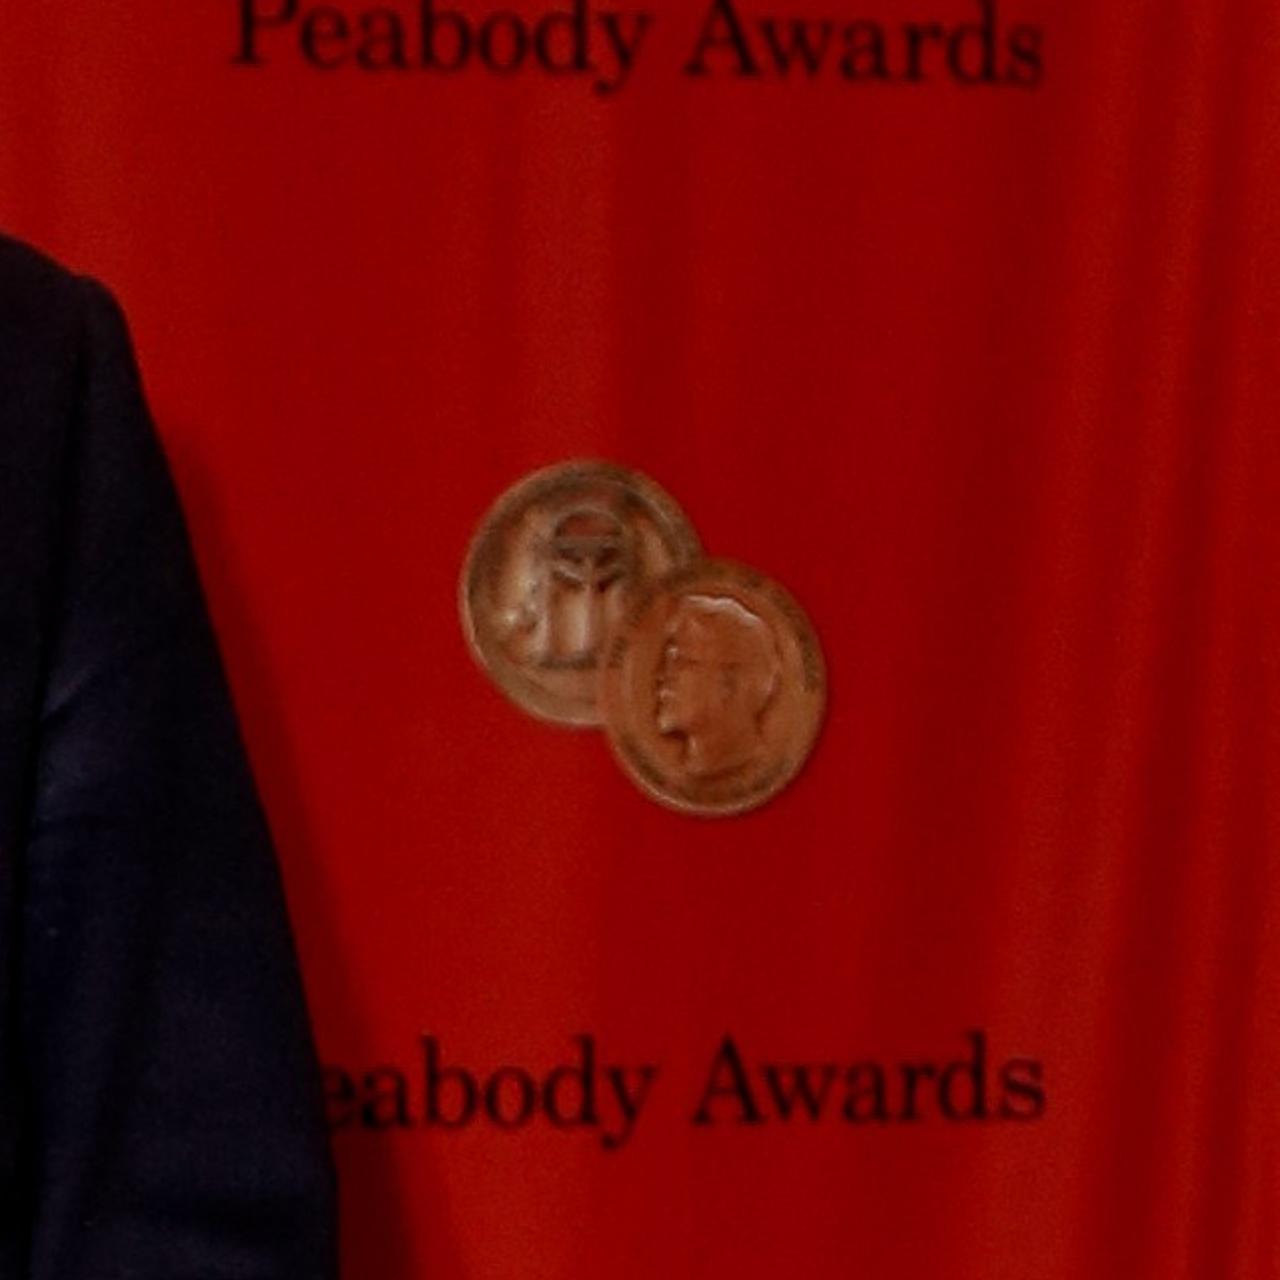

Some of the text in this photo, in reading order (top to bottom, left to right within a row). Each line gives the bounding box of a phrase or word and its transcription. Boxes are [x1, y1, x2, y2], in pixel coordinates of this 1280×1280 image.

[233, 0, 1042, 96] Peabody Awards
[691, 1032, 1046, 1126] Awards
